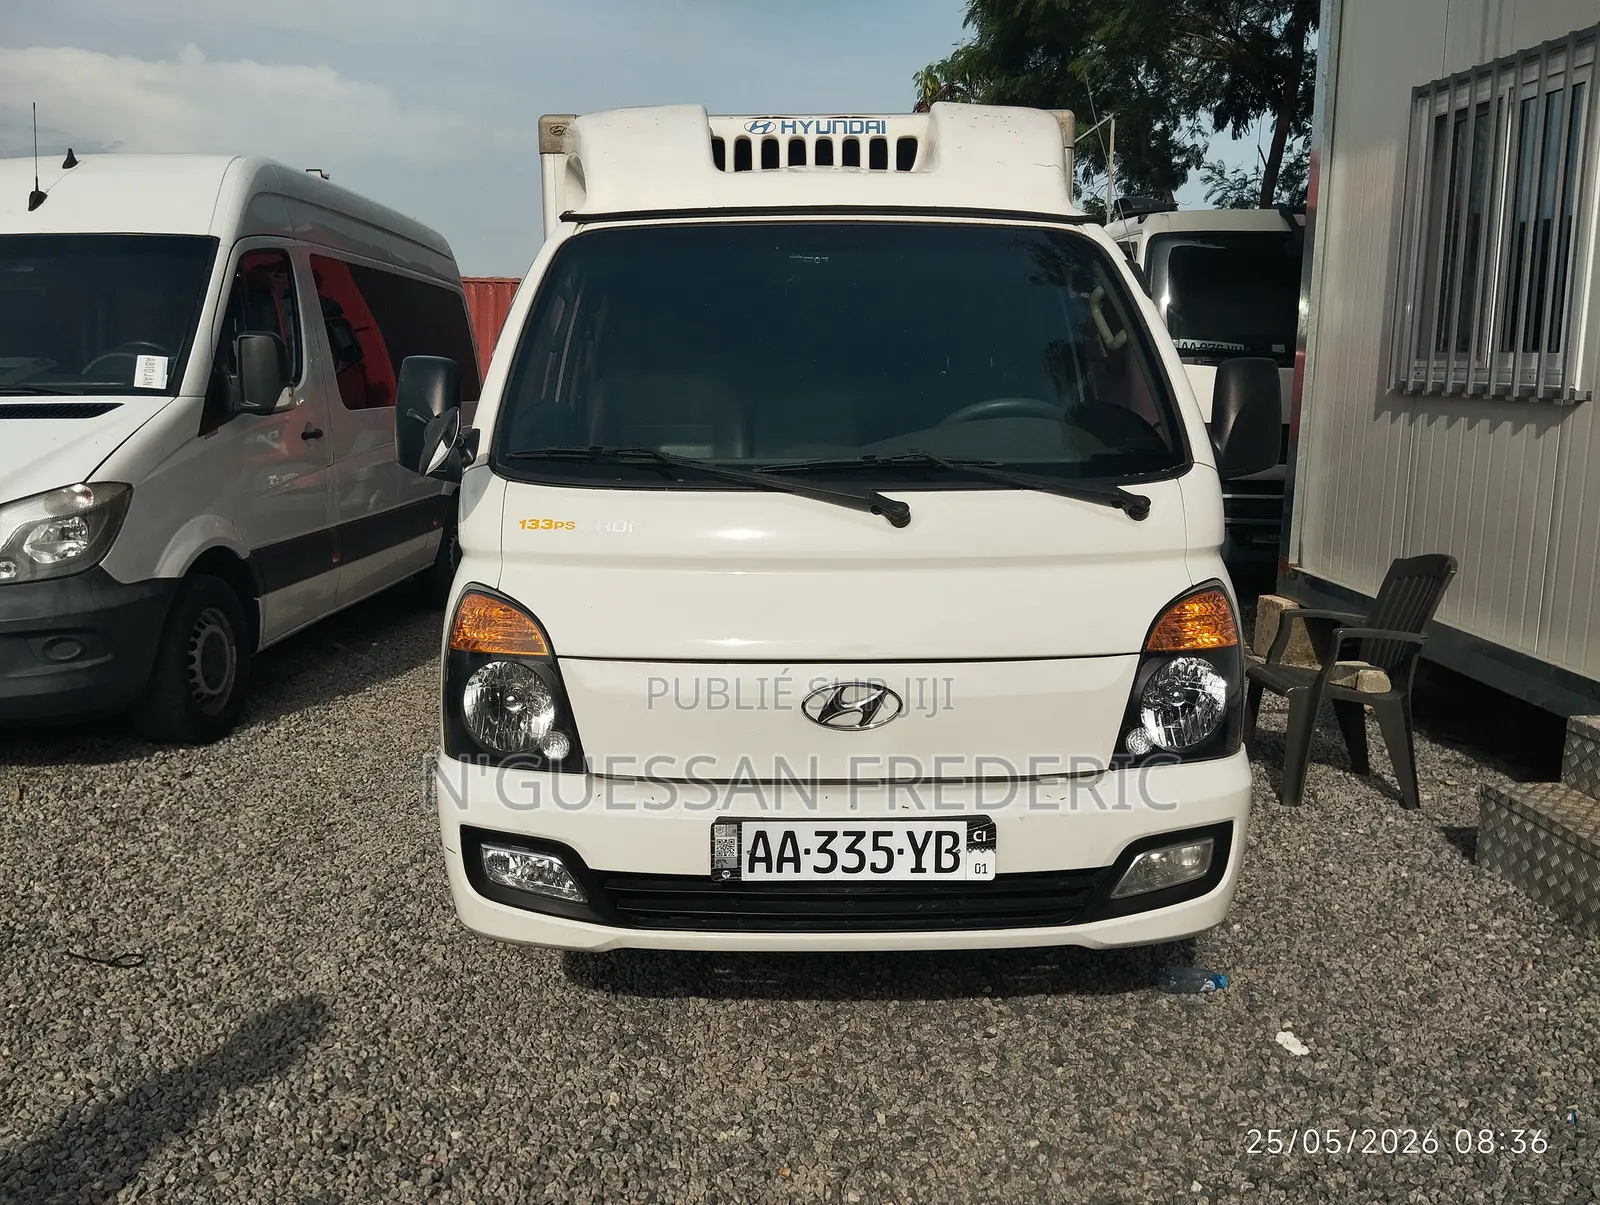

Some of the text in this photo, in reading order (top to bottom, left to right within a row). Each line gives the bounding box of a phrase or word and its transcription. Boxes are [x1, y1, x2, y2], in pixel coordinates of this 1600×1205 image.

[781, 120, 886, 135] HYUNDAI
[142, 357, 156, 387] ABIDJAN
[519, 518, 576, 531] 133PS
[972, 830, 987, 842] CI
[974, 862, 988, 875] 01
